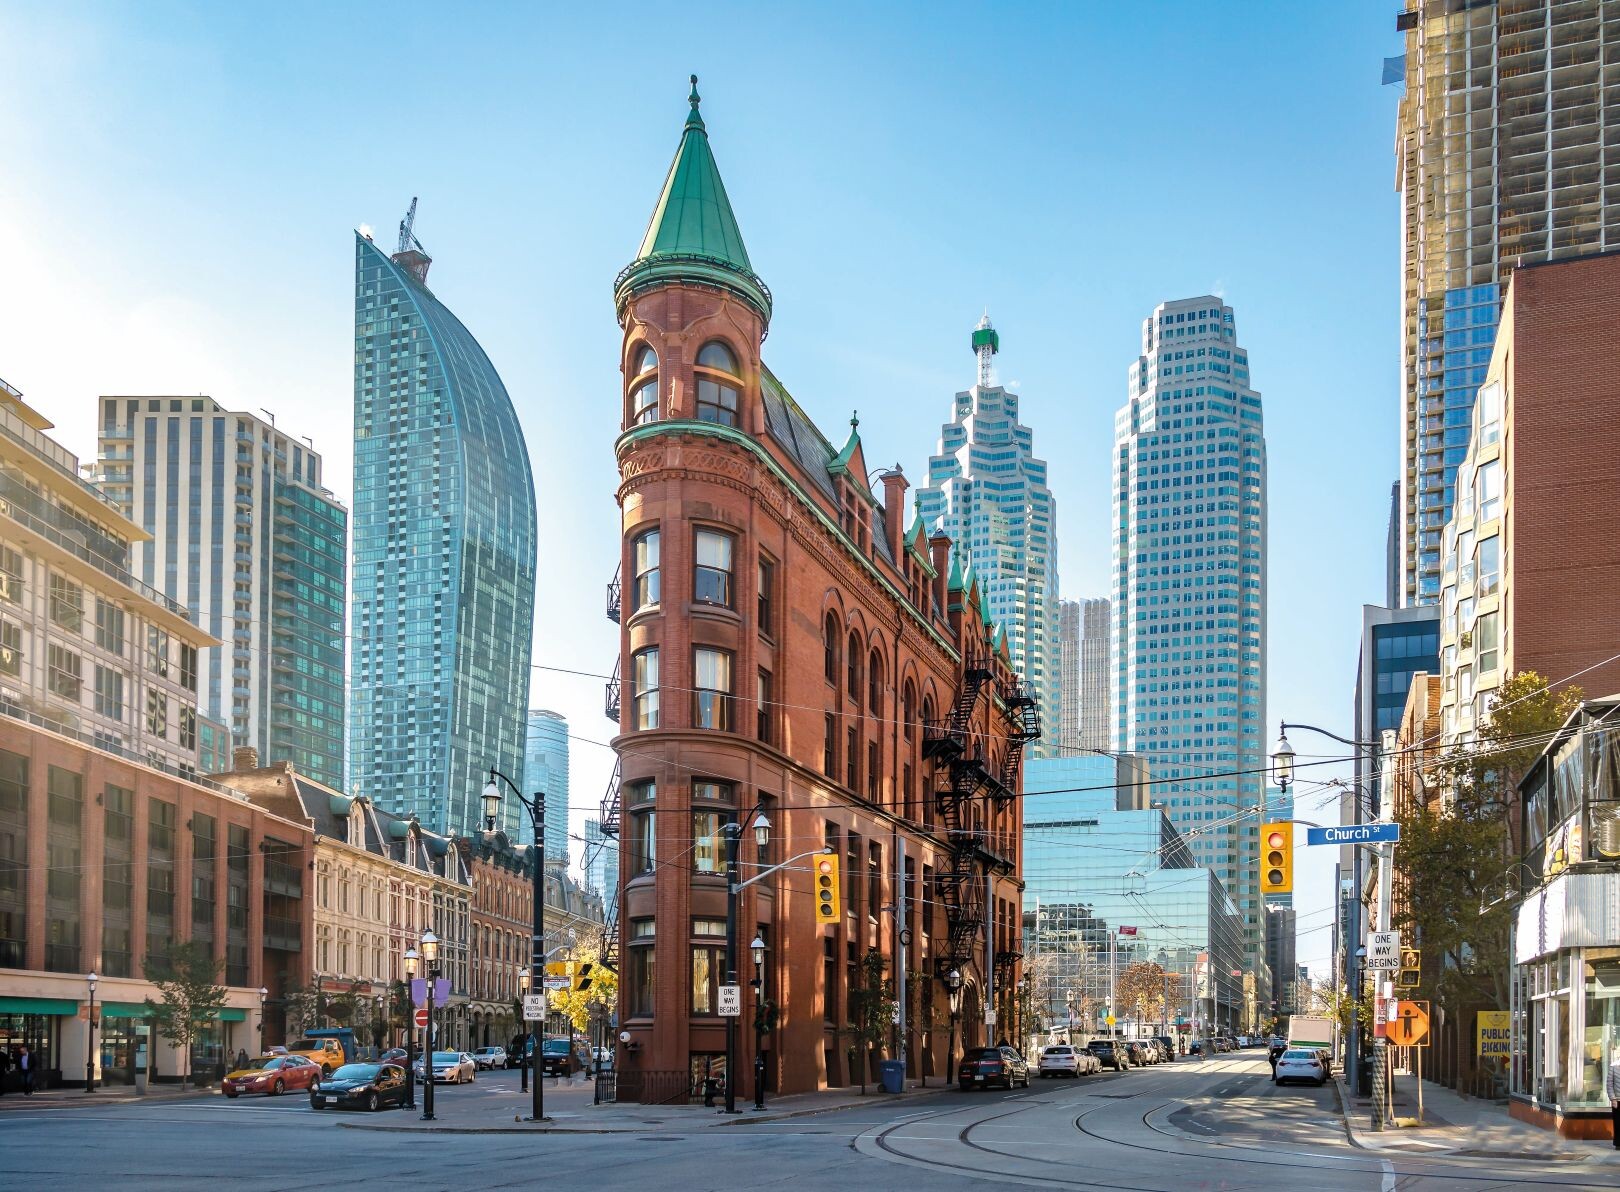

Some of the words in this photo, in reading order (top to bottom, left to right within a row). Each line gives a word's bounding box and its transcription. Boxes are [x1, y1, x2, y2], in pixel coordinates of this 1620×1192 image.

[1325, 827, 1370, 840] Church
[1375, 934, 1392, 944] ONE
[1375, 946, 1391, 956] WAY
[1368, 958, 1399, 968] BEGINS
[1481, 1028, 1511, 1040] PUBLIC
